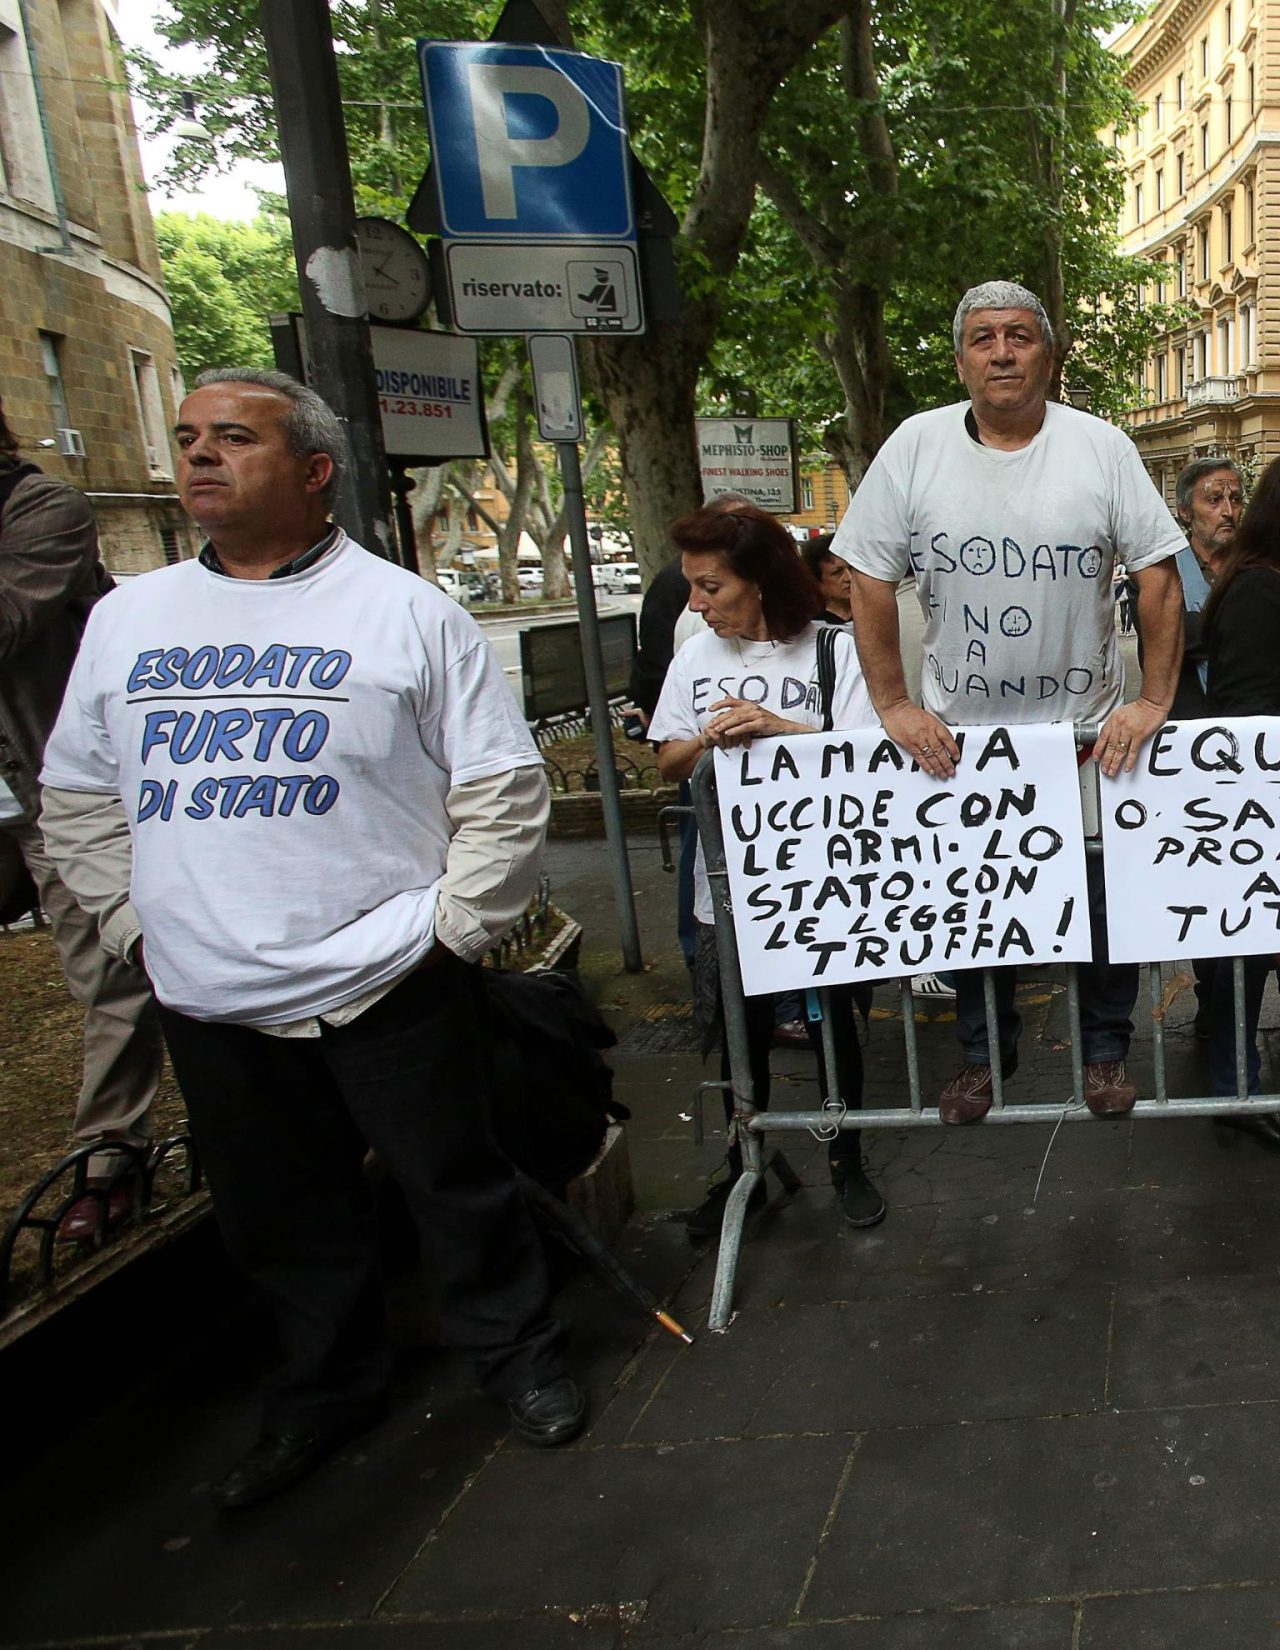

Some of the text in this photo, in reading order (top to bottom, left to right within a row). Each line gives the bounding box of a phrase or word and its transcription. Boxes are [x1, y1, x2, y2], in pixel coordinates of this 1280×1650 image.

[468, 64, 590, 219] P
[463, 278, 562, 298] riservato:
[375, 370, 471, 400] DISPONIBILE
[702, 444, 788, 456] MEPHISTO-SHOP
[702, 467, 789, 477] FINEST WALKING SHOES
[910, 532, 1103, 581] ESODATO
[126, 643, 352, 692] ESODATO
[966, 639, 986, 667] A
[141, 707, 330, 766] FURTO
[741, 744, 799, 786] LA
[137, 774, 340, 824] DI STATO
[731, 784, 1037, 842] UCCIDE CON
[743, 838, 802, 876] LE
[983, 825, 1064, 861] LO
[947, 864, 1038, 899] CON
[1243, 871, 1280, 901] A
[764, 899, 992, 950] LE LEGGI
